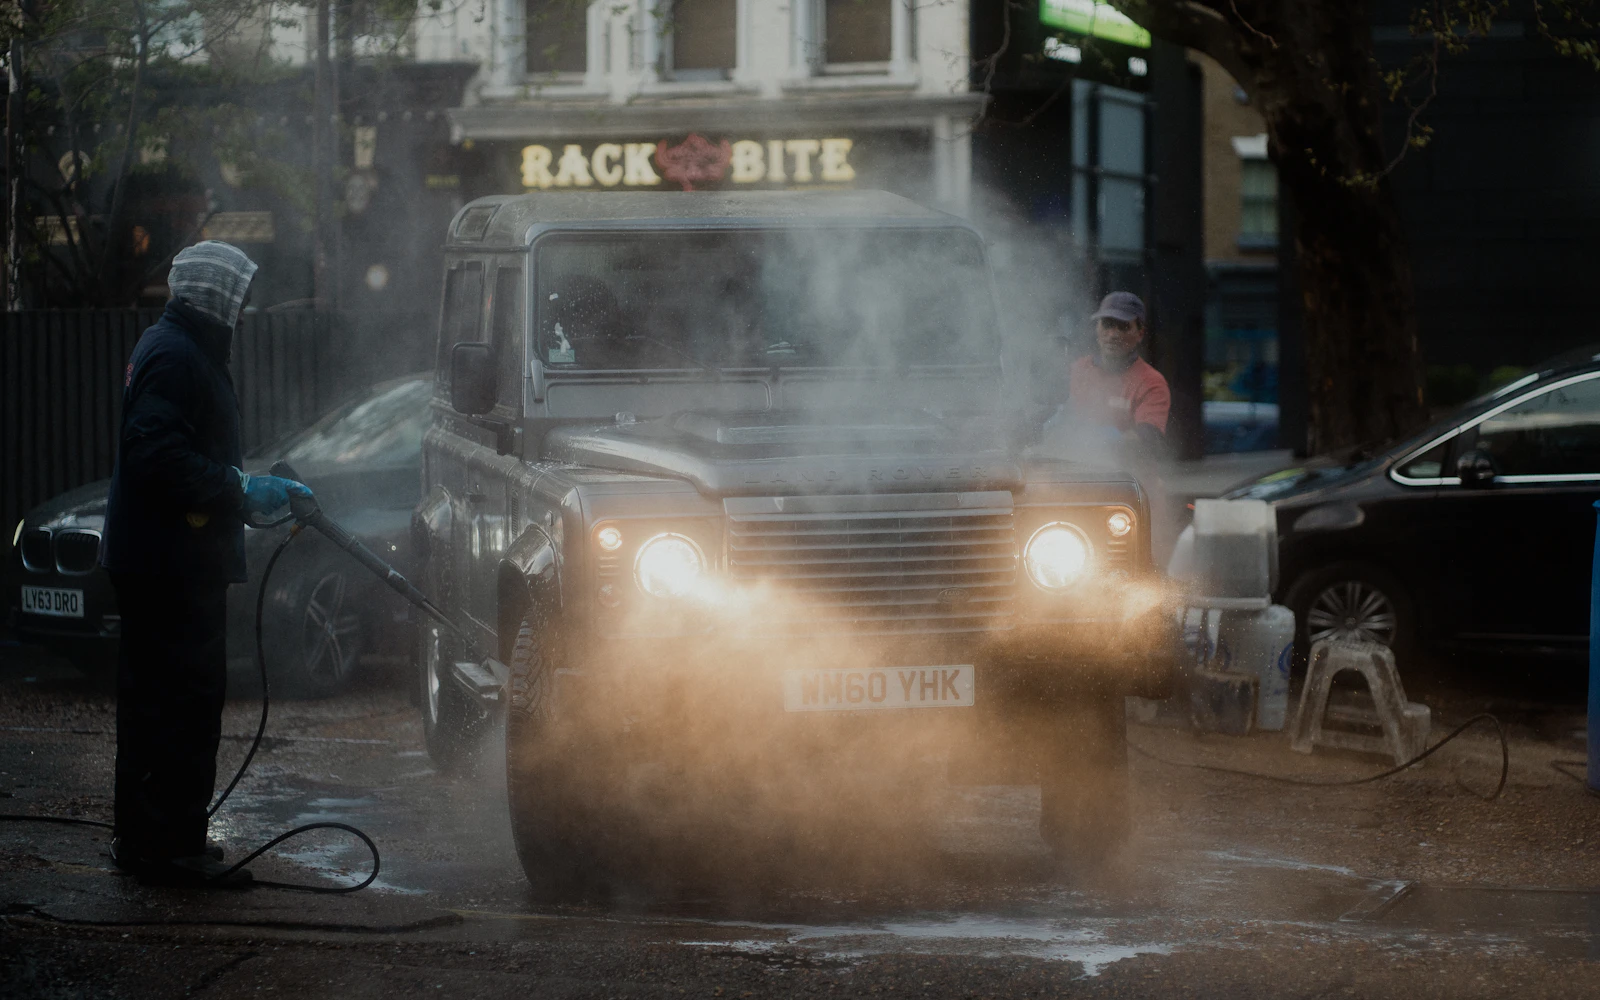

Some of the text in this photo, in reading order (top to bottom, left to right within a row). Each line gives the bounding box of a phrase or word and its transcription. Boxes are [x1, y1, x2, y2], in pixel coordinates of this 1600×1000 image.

[521, 138, 856, 187] RACK BITE
[744, 466, 988, 484] LAND ROVER
[25, 588, 78, 612] LY63 DRO
[898, 669, 961, 702] YHK
